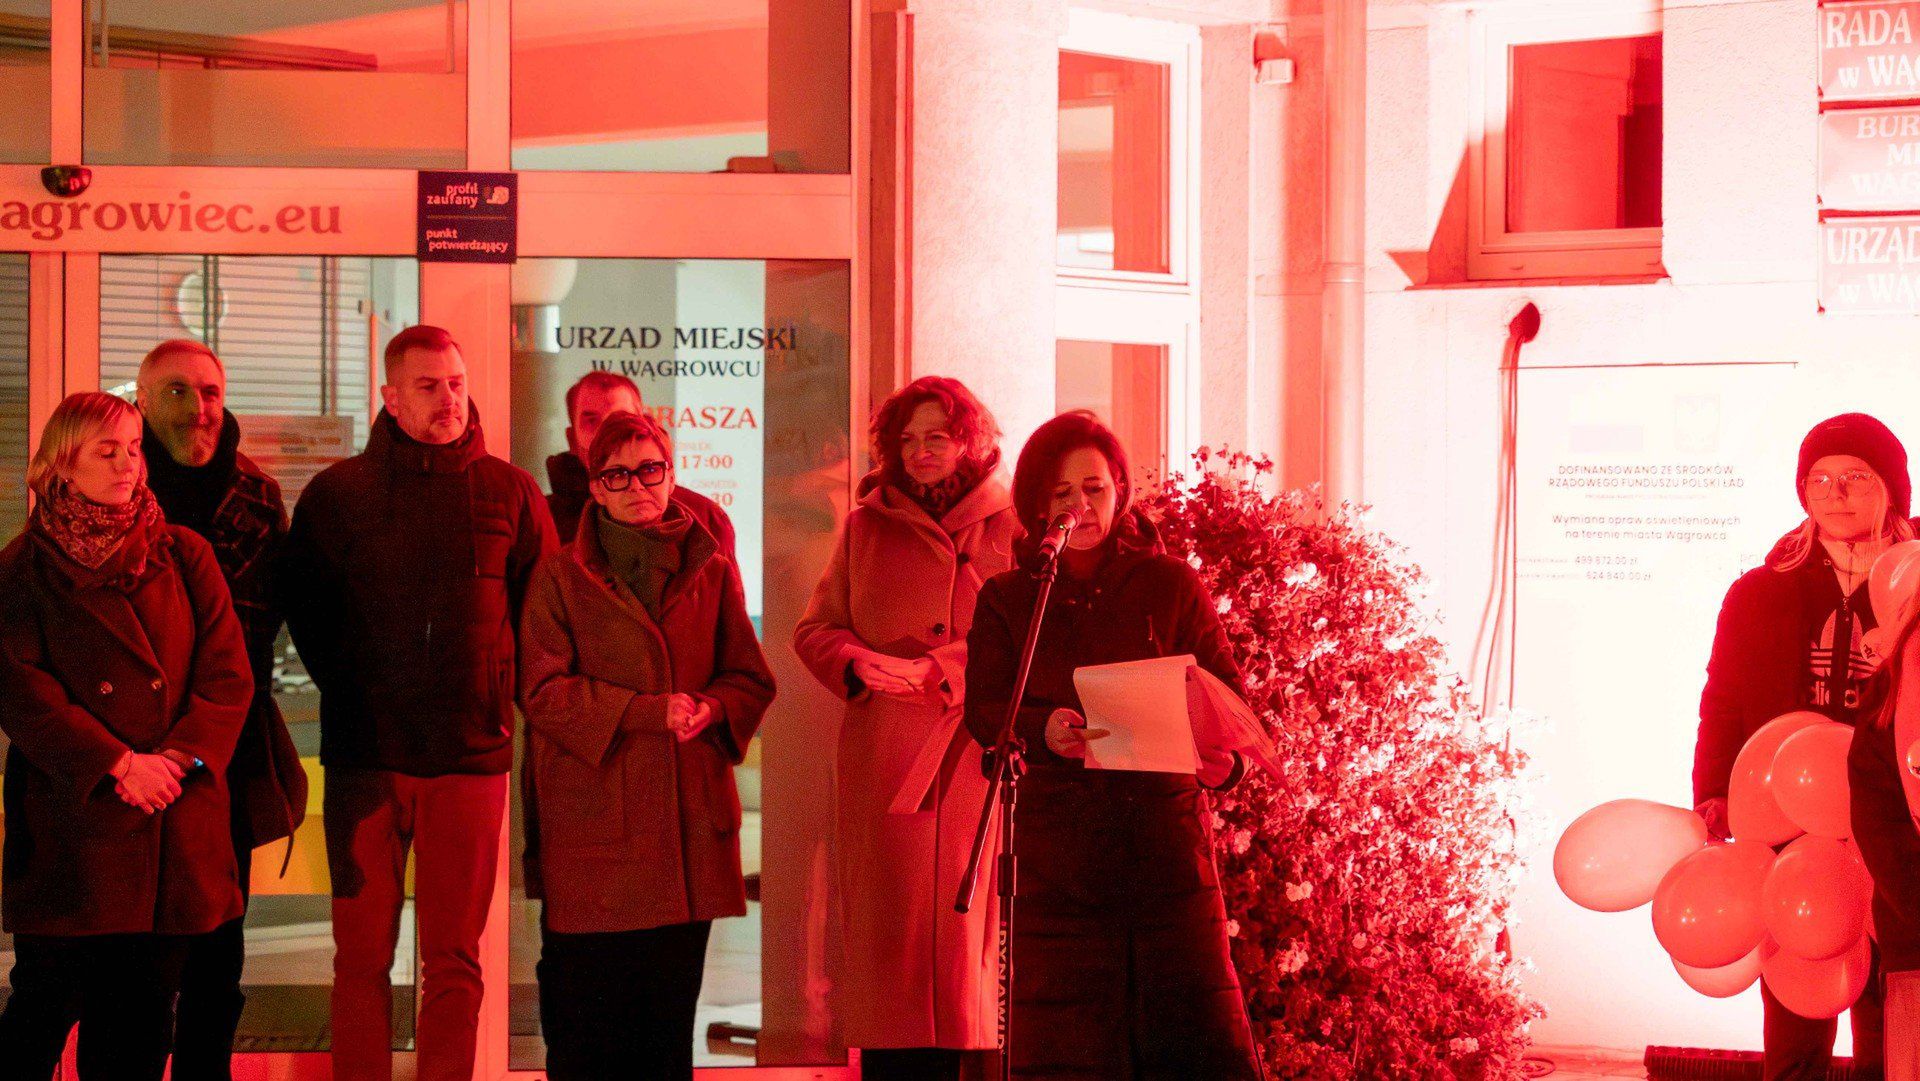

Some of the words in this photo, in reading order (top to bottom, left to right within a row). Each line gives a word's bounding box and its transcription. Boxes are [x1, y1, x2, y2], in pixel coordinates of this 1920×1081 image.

[1825, 8, 1912, 48] RADA
[1866, 54, 1920, 90] WĄ
[446, 182, 478, 196] profil
[427, 192, 478, 208] zaufany
[0, 191, 342, 240] agrowiec.eu
[426, 228, 457, 240] punkt
[428, 240, 508, 253] potwierdzający
[555, 326, 662, 355] URZĄD
[674, 325, 797, 350] MIEJSKI
[620, 360, 761, 382] WĄGROWCU
[1558, 465, 1658, 475] DOFINANSOWANO
[1660, 465, 1672, 475] ZE
[1621, 478, 1679, 488] FUNDUSZU
[1681, 478, 1720, 488] POLSKI
[1722, 478, 1744, 488] ŁAD
[1552, 514, 1605, 527] Wymiana
[1608, 516, 1642, 527] opraw
[1565, 530, 1579, 539] na
[1581, 529, 1620, 539] terenie
